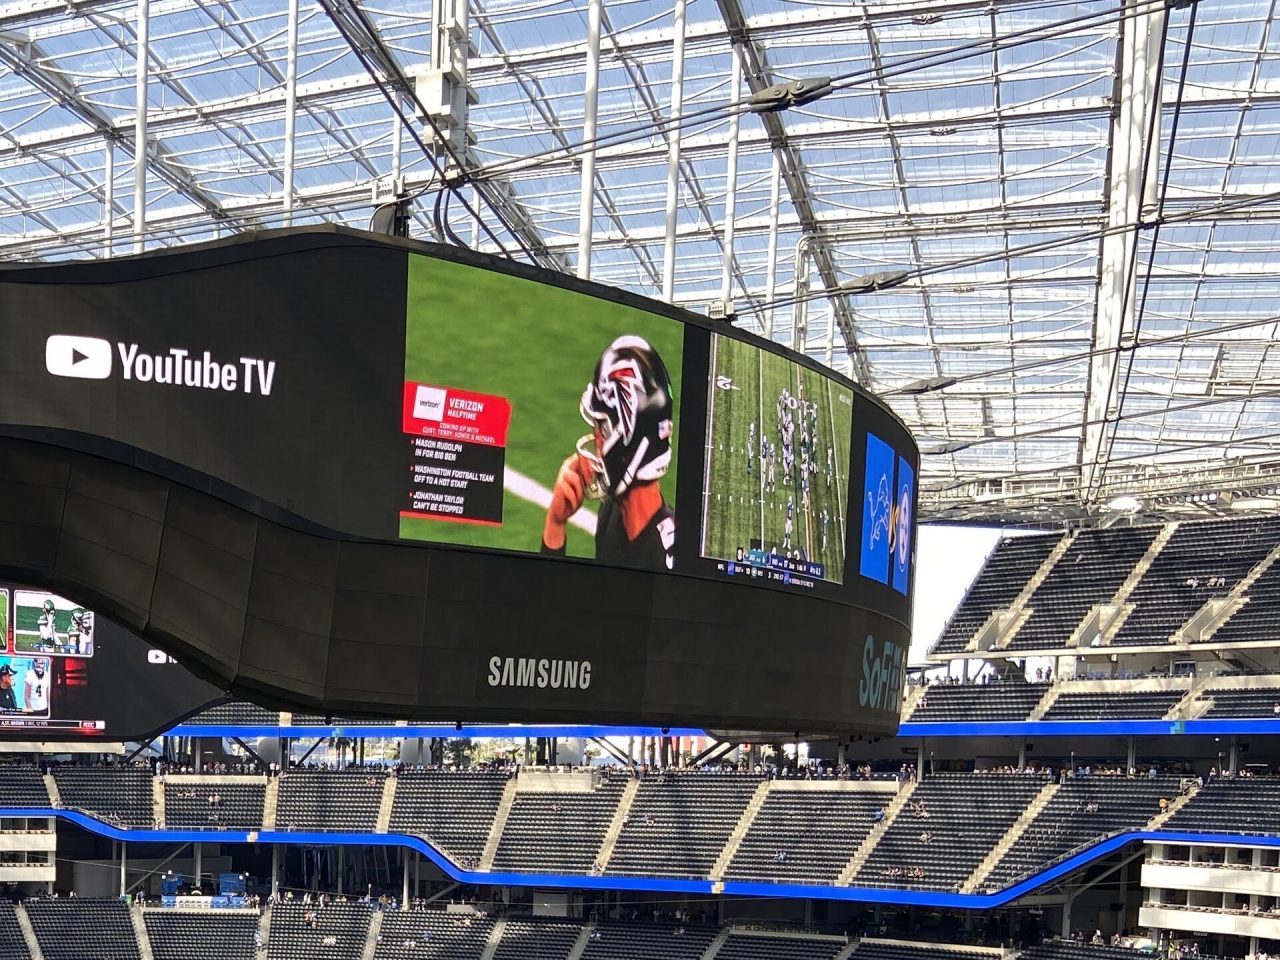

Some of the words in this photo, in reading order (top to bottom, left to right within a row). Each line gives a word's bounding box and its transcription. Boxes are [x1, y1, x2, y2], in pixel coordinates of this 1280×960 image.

[118, 342, 237, 391] YouTube
[240, 357, 275, 396] TV
[420, 400, 440, 408] verizon
[449, 398, 484, 412] VERIZON
[448, 409, 477, 421] HALFTIME
[440, 422, 458, 430] COMING
[415, 438, 436, 449] MASON
[437, 441, 462, 452] RUDOLPH
[476, 434, 495, 444] MICHAEL
[434, 451, 444, 459] BIG
[444, 453, 456, 461] BEN
[414, 465, 451, 477] WASHINGTON
[452, 470, 478, 481] FOOTBALL
[479, 473, 494, 482] TEAM
[414, 475, 426, 483] OFF
[426, 476, 433, 484] TO
[433, 477, 438, 485] A
[439, 478, 450, 486] HOT
[450, 480, 468, 488] START
[413, 492, 443, 501] JONATHAN
[444, 494, 464, 504] TAYLOR
[413, 501, 430, 510] CAN'T
[430, 503, 438, 511] BE
[439, 504, 464, 514] STOPPED
[488, 656, 591, 690] SAMSUNG
[859, 634, 894, 711] SoFi
